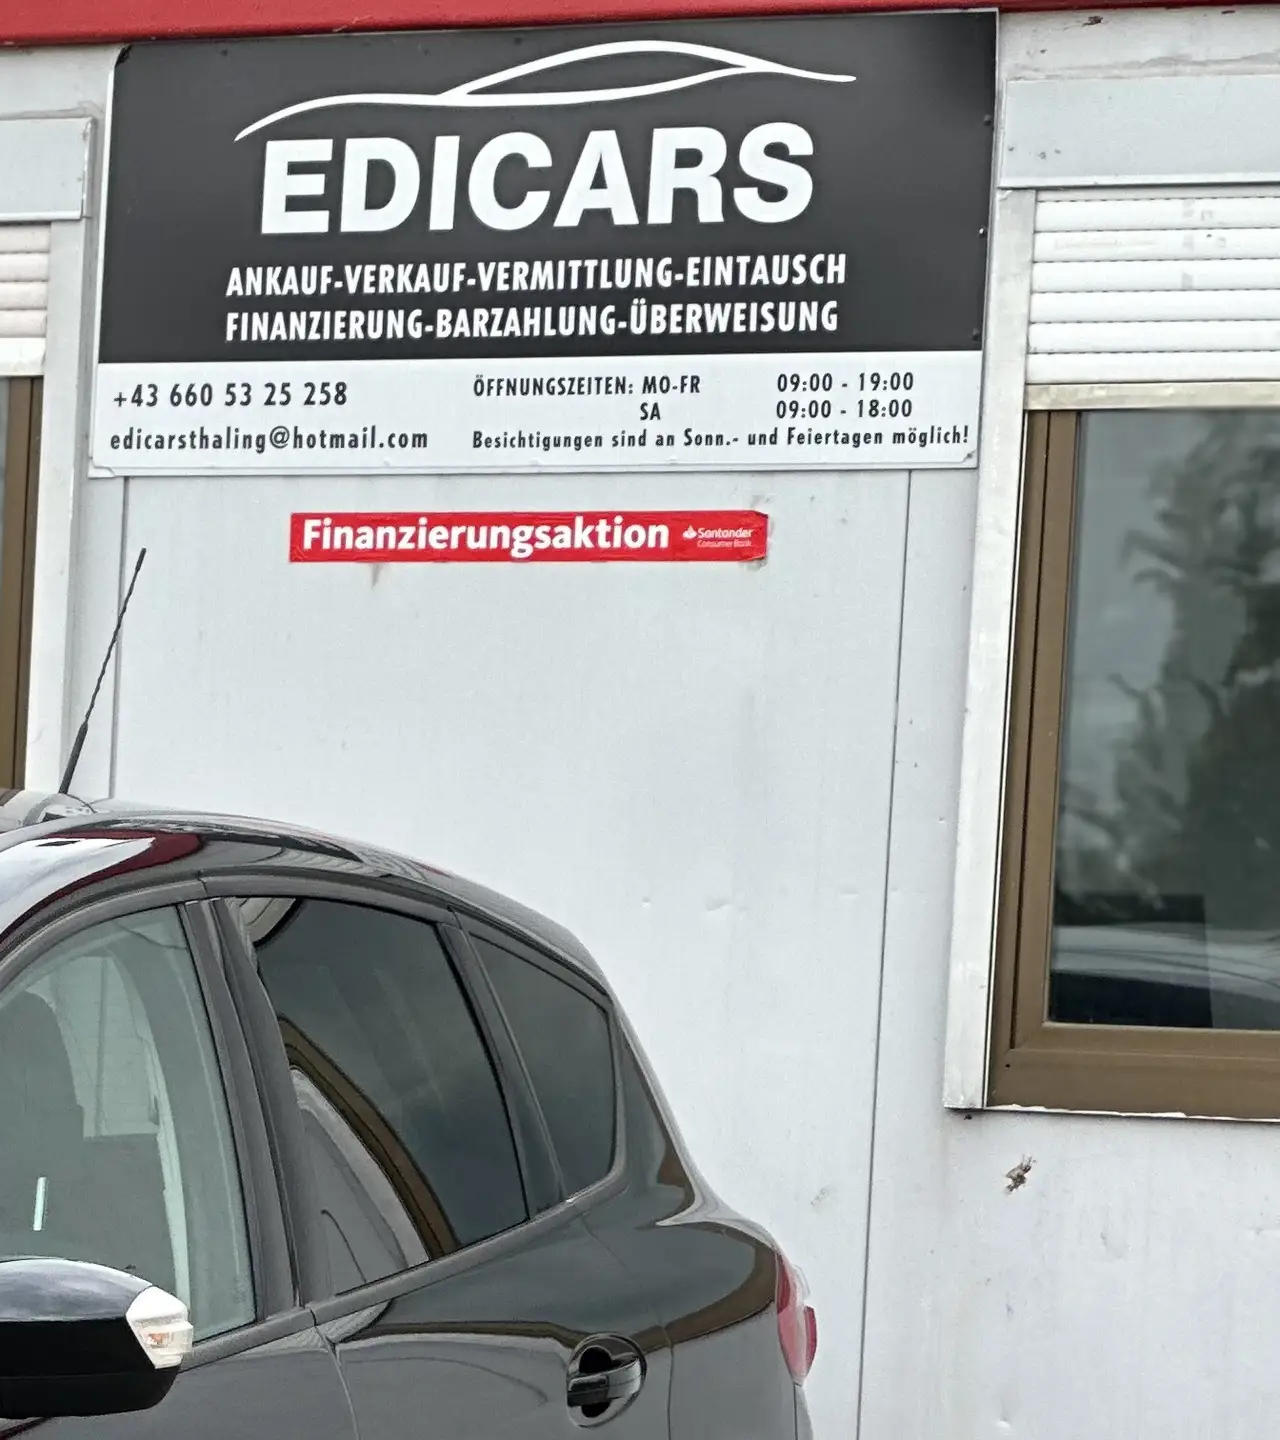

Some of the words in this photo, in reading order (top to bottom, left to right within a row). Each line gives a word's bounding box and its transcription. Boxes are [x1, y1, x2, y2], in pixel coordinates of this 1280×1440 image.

[260, 121, 815, 236] EDICARS
[225, 253, 847, 297] ANKAUF-VERKAUF-VERMITTLUNG-EINTAUSCH
[225, 297, 839, 342] FINANZIERUNG-BARZAHLUNG-ÜBERWEISUNG
[113, 384, 159, 408] +43
[170, 382, 213, 407] 660
[224, 382, 252, 407] 53
[264, 382, 292, 406] 25
[303, 381, 348, 406] 258
[473, 374, 634, 397] ÖFFNUNGSZEITEN:
[642, 375, 701, 394] MO-FR
[777, 372, 833, 392] 09:00
[859, 371, 914, 391] 19:00
[640, 402, 661, 421] SA
[776, 400, 832, 418] 09:00
[857, 399, 913, 418] 18:00
[110, 425, 428, 454] edicarsthaling@hotmail.com
[472, 430, 603, 451] Besichtigungen
[612, 428, 647, 447] sind
[655, 434, 675, 447] an
[683, 427, 739, 447] Sonn.-
[747, 427, 778, 445] und
[787, 426, 883, 448] Feiertagen
[892, 425, 969, 448] möglich!
[303, 515, 670, 560] Finanzierungsaktion
[697, 526, 754, 538] Santander
